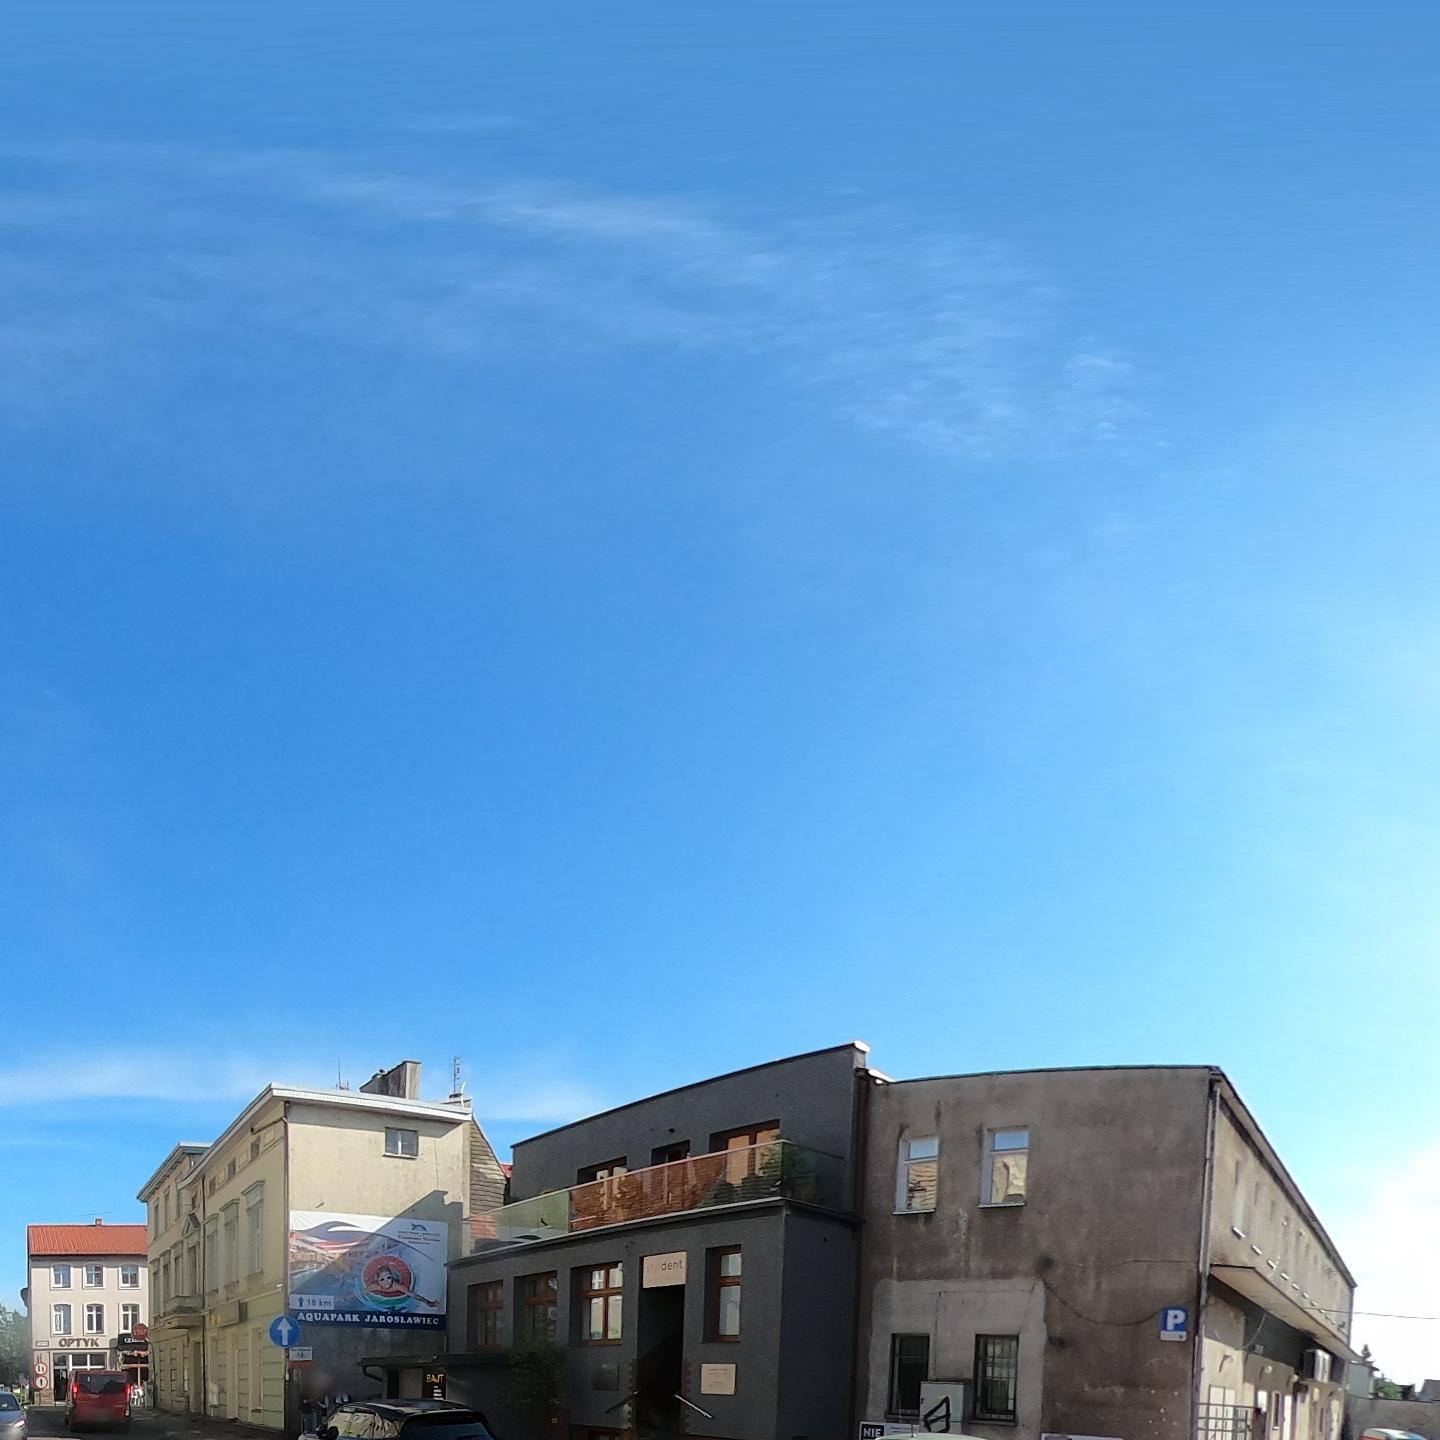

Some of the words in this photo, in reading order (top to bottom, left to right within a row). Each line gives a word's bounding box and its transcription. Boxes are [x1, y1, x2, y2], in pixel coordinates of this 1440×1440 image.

[297, 1312, 361, 1323] AQUAPARK
[1166, 1309, 1186, 1331] P
[58, 1338, 100, 1348] OPTYK
[863, 1427, 882, 1438] NIE
